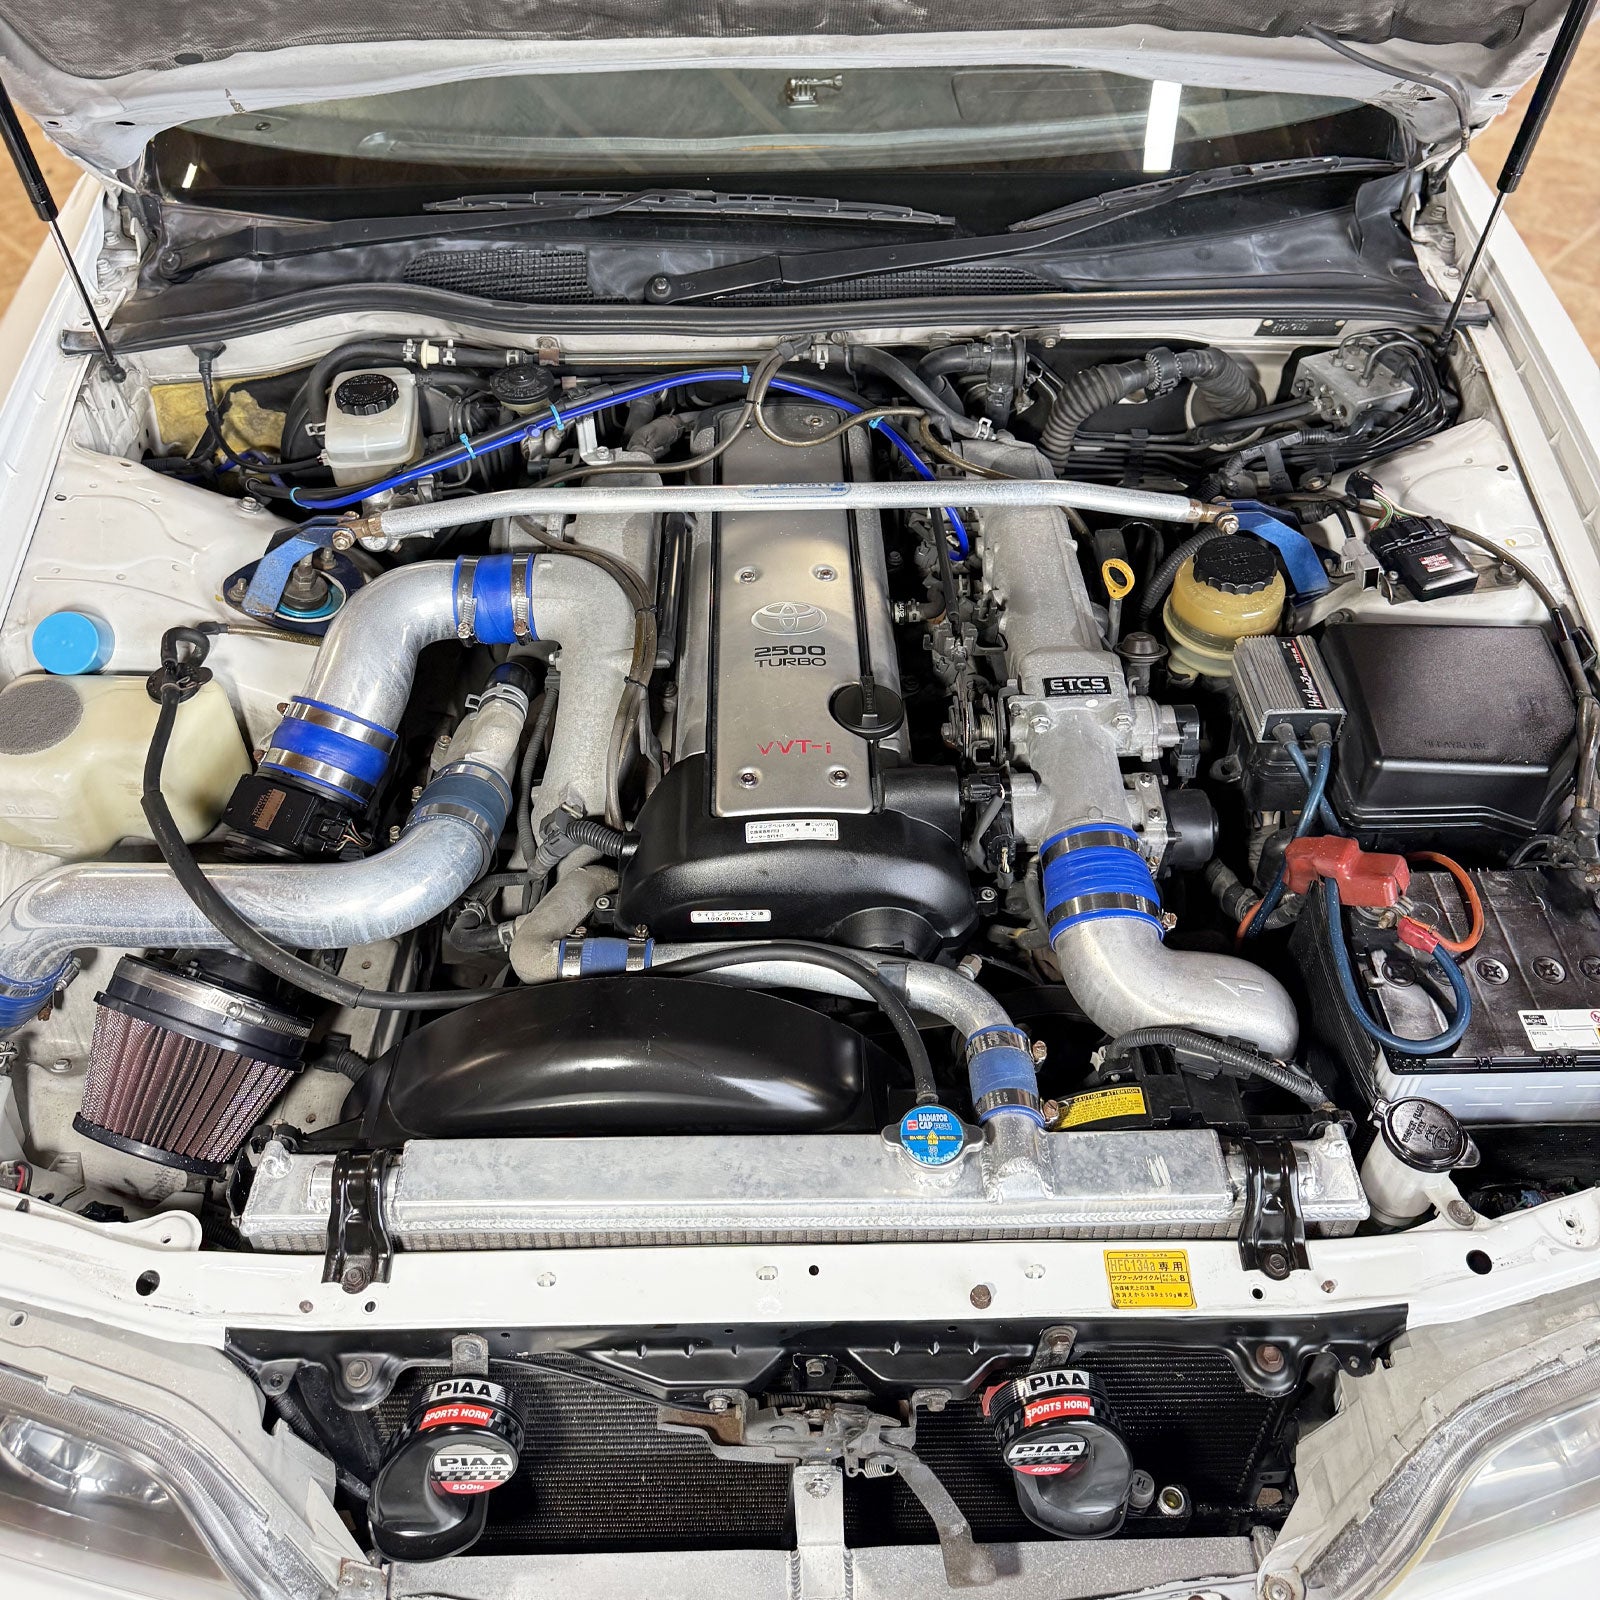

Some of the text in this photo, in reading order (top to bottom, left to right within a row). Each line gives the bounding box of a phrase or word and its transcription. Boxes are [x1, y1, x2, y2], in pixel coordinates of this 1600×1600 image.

[754, 645, 826, 658] 2500
[754, 657, 827, 668] TURBO
[1050, 678, 1106, 691] ETCS
[756, 740, 832, 755] VVT-i
[251, 793, 267, 817] TOYOTA
[1073, 1093, 1102, 1103] CAUTION
[918, 1113, 948, 1122] RADIATOR
[1110, 1259, 1156, 1272] HFC134a
[1179, 1274, 1186, 1282] 8
[1029, 1372, 1086, 1391] PIAA
[436, 1381, 492, 1397] PIAA
[424, 1408, 489, 1422] SPORTS HORN
[1025, 1400, 1089, 1419] SPORTS HORN
[1015, 1444, 1080, 1454] PIAA
[439, 1457, 509, 1466] PIAA
